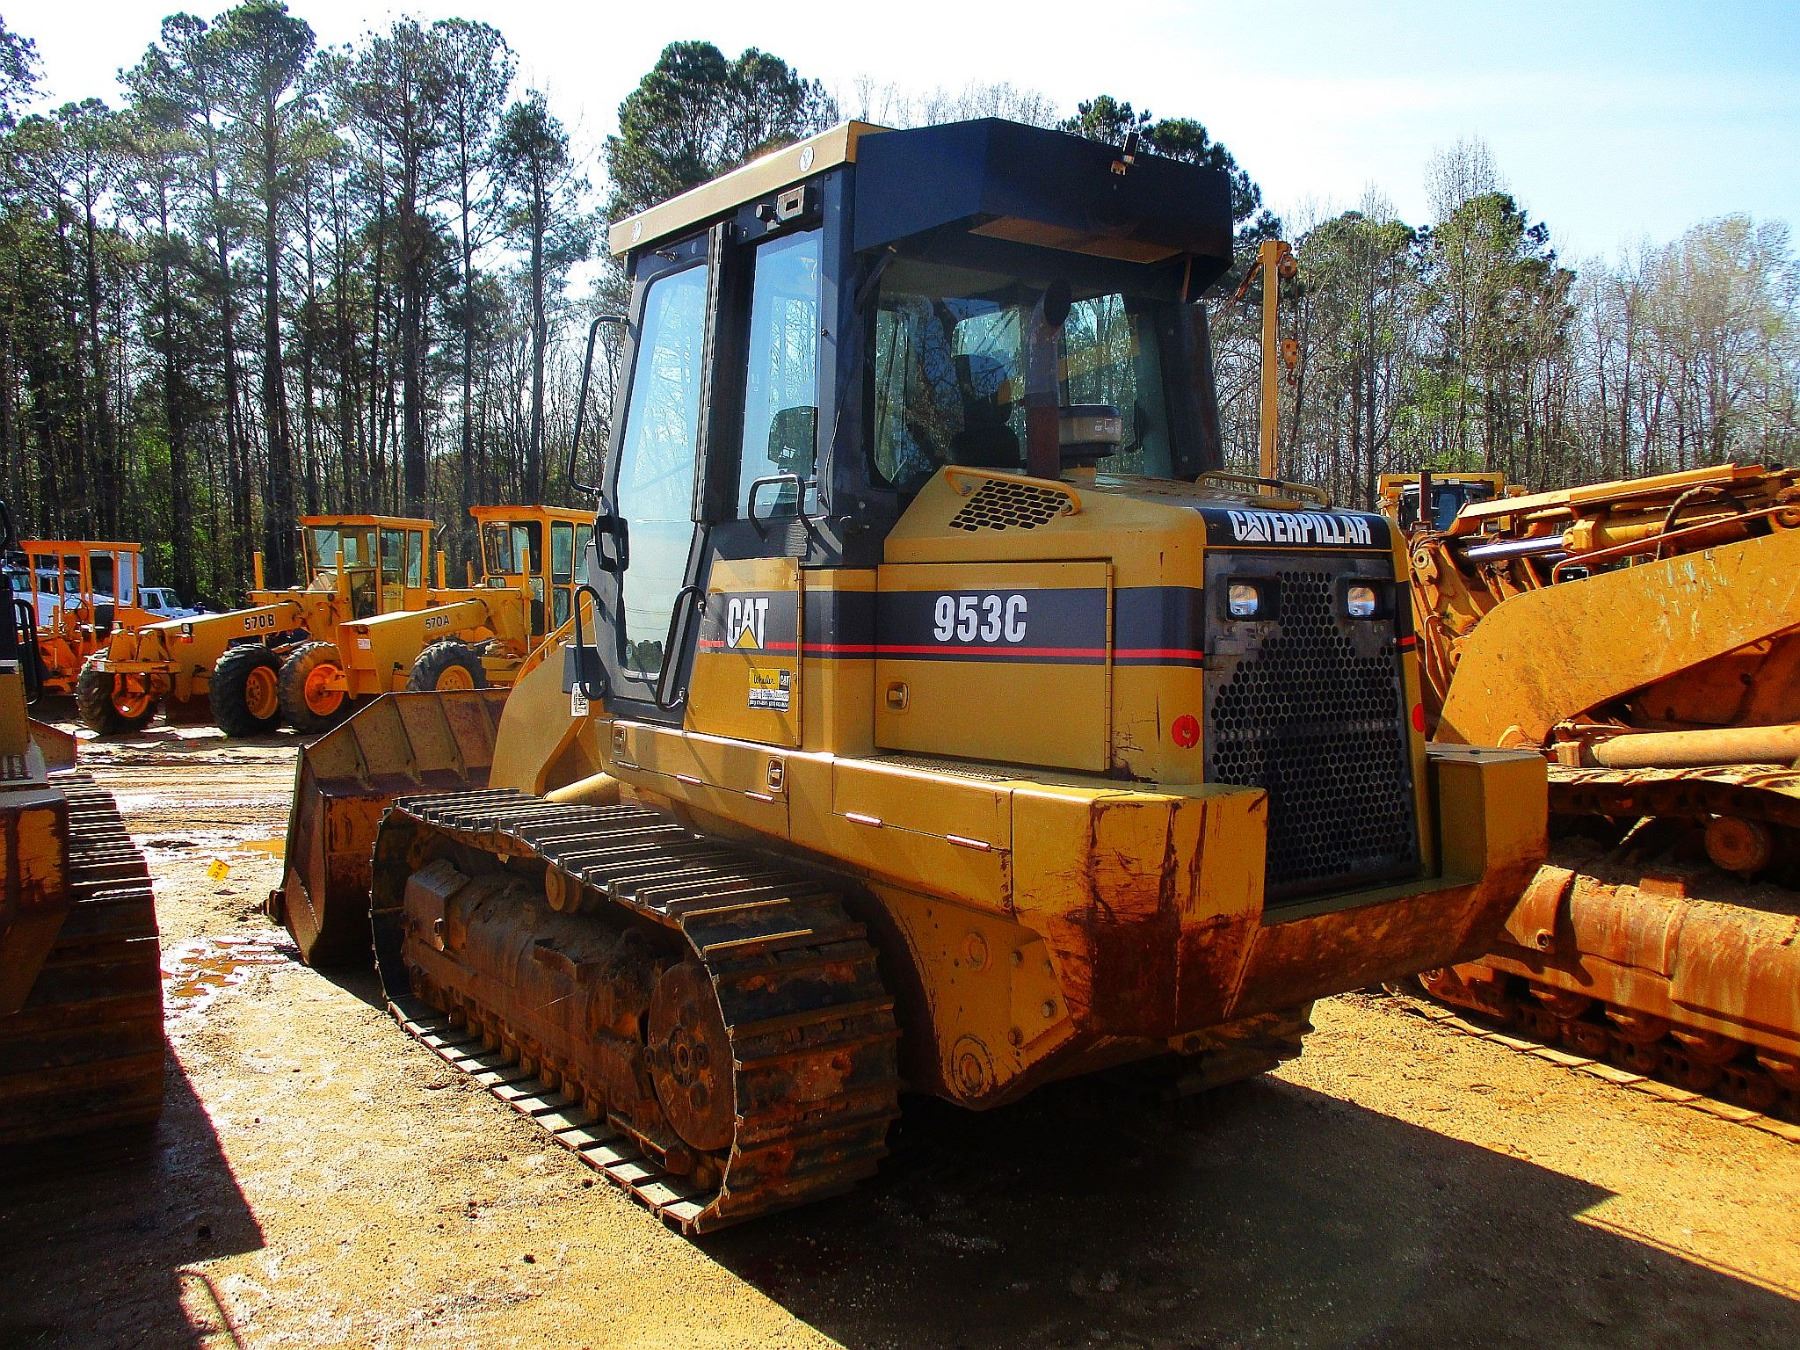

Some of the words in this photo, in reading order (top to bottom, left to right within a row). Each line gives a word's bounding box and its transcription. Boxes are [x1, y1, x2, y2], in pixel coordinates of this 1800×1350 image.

[1227, 510, 1372, 545] CATERPILLAR
[244, 614, 275, 631] 570B
[425, 614, 450, 630] 570A
[726, 597, 769, 650] CAT
[933, 594, 1028, 643] 953C
